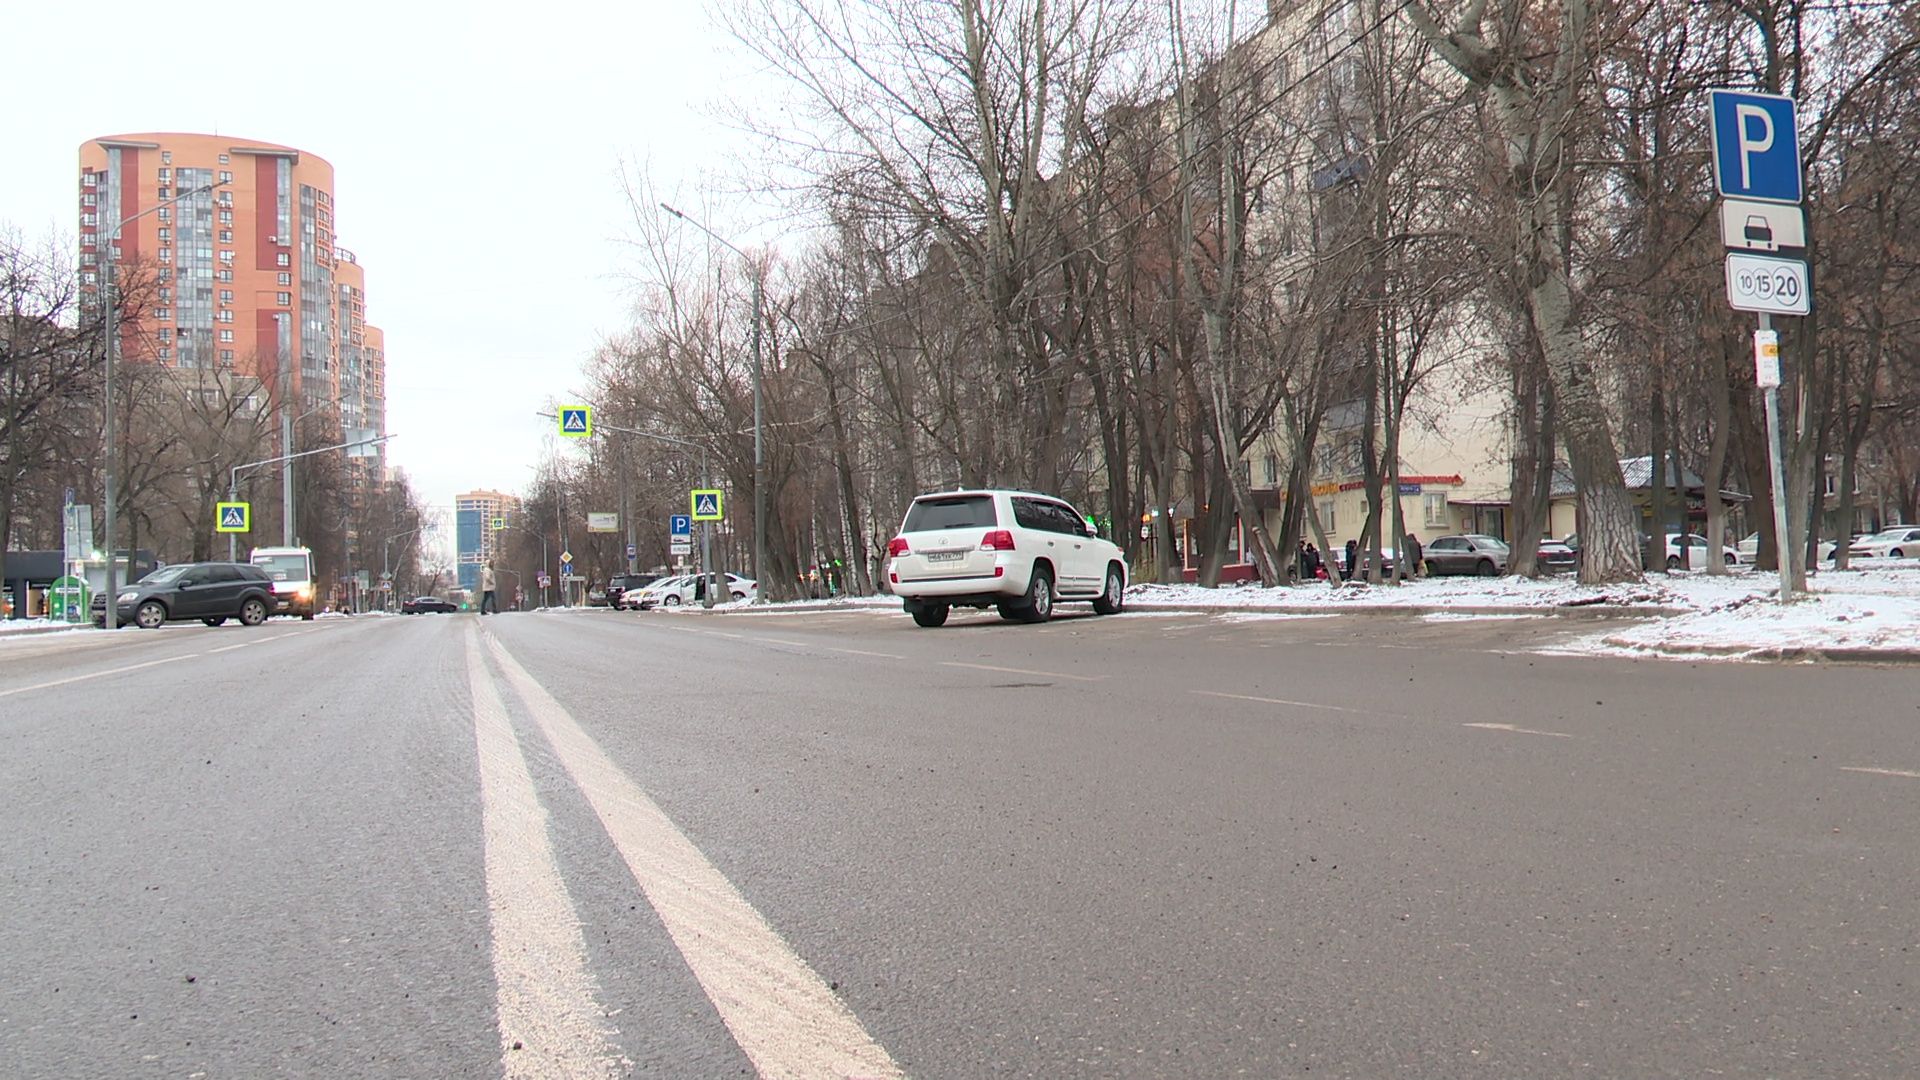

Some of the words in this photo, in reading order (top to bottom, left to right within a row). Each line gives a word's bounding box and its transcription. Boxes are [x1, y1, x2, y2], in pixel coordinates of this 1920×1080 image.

[1736, 103, 1775, 190] P
[1740, 275, 1753, 288] 10
[1756, 275, 1771, 293] 15
[1775, 275, 1798, 297] 20
[676, 517, 686, 533] P
